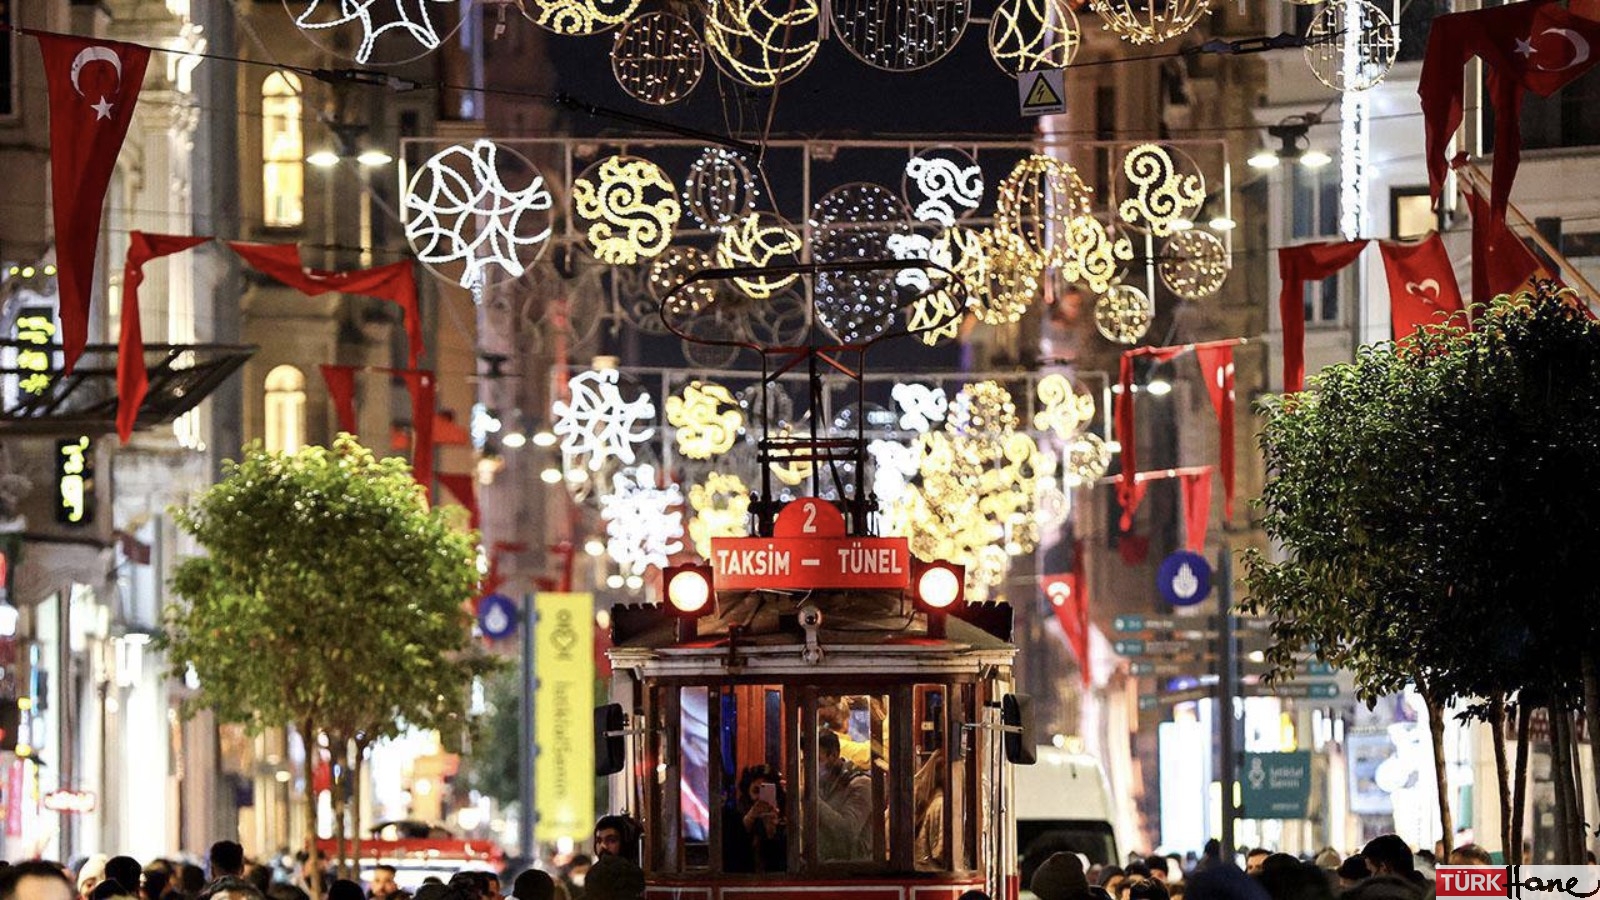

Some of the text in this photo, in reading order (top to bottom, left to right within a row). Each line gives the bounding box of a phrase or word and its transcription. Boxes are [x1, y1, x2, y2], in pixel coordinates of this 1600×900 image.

[802, 502, 817, 533] 2
[717, 544, 790, 576] TAKSİM
[838, 542, 902, 574] TÜNEL
